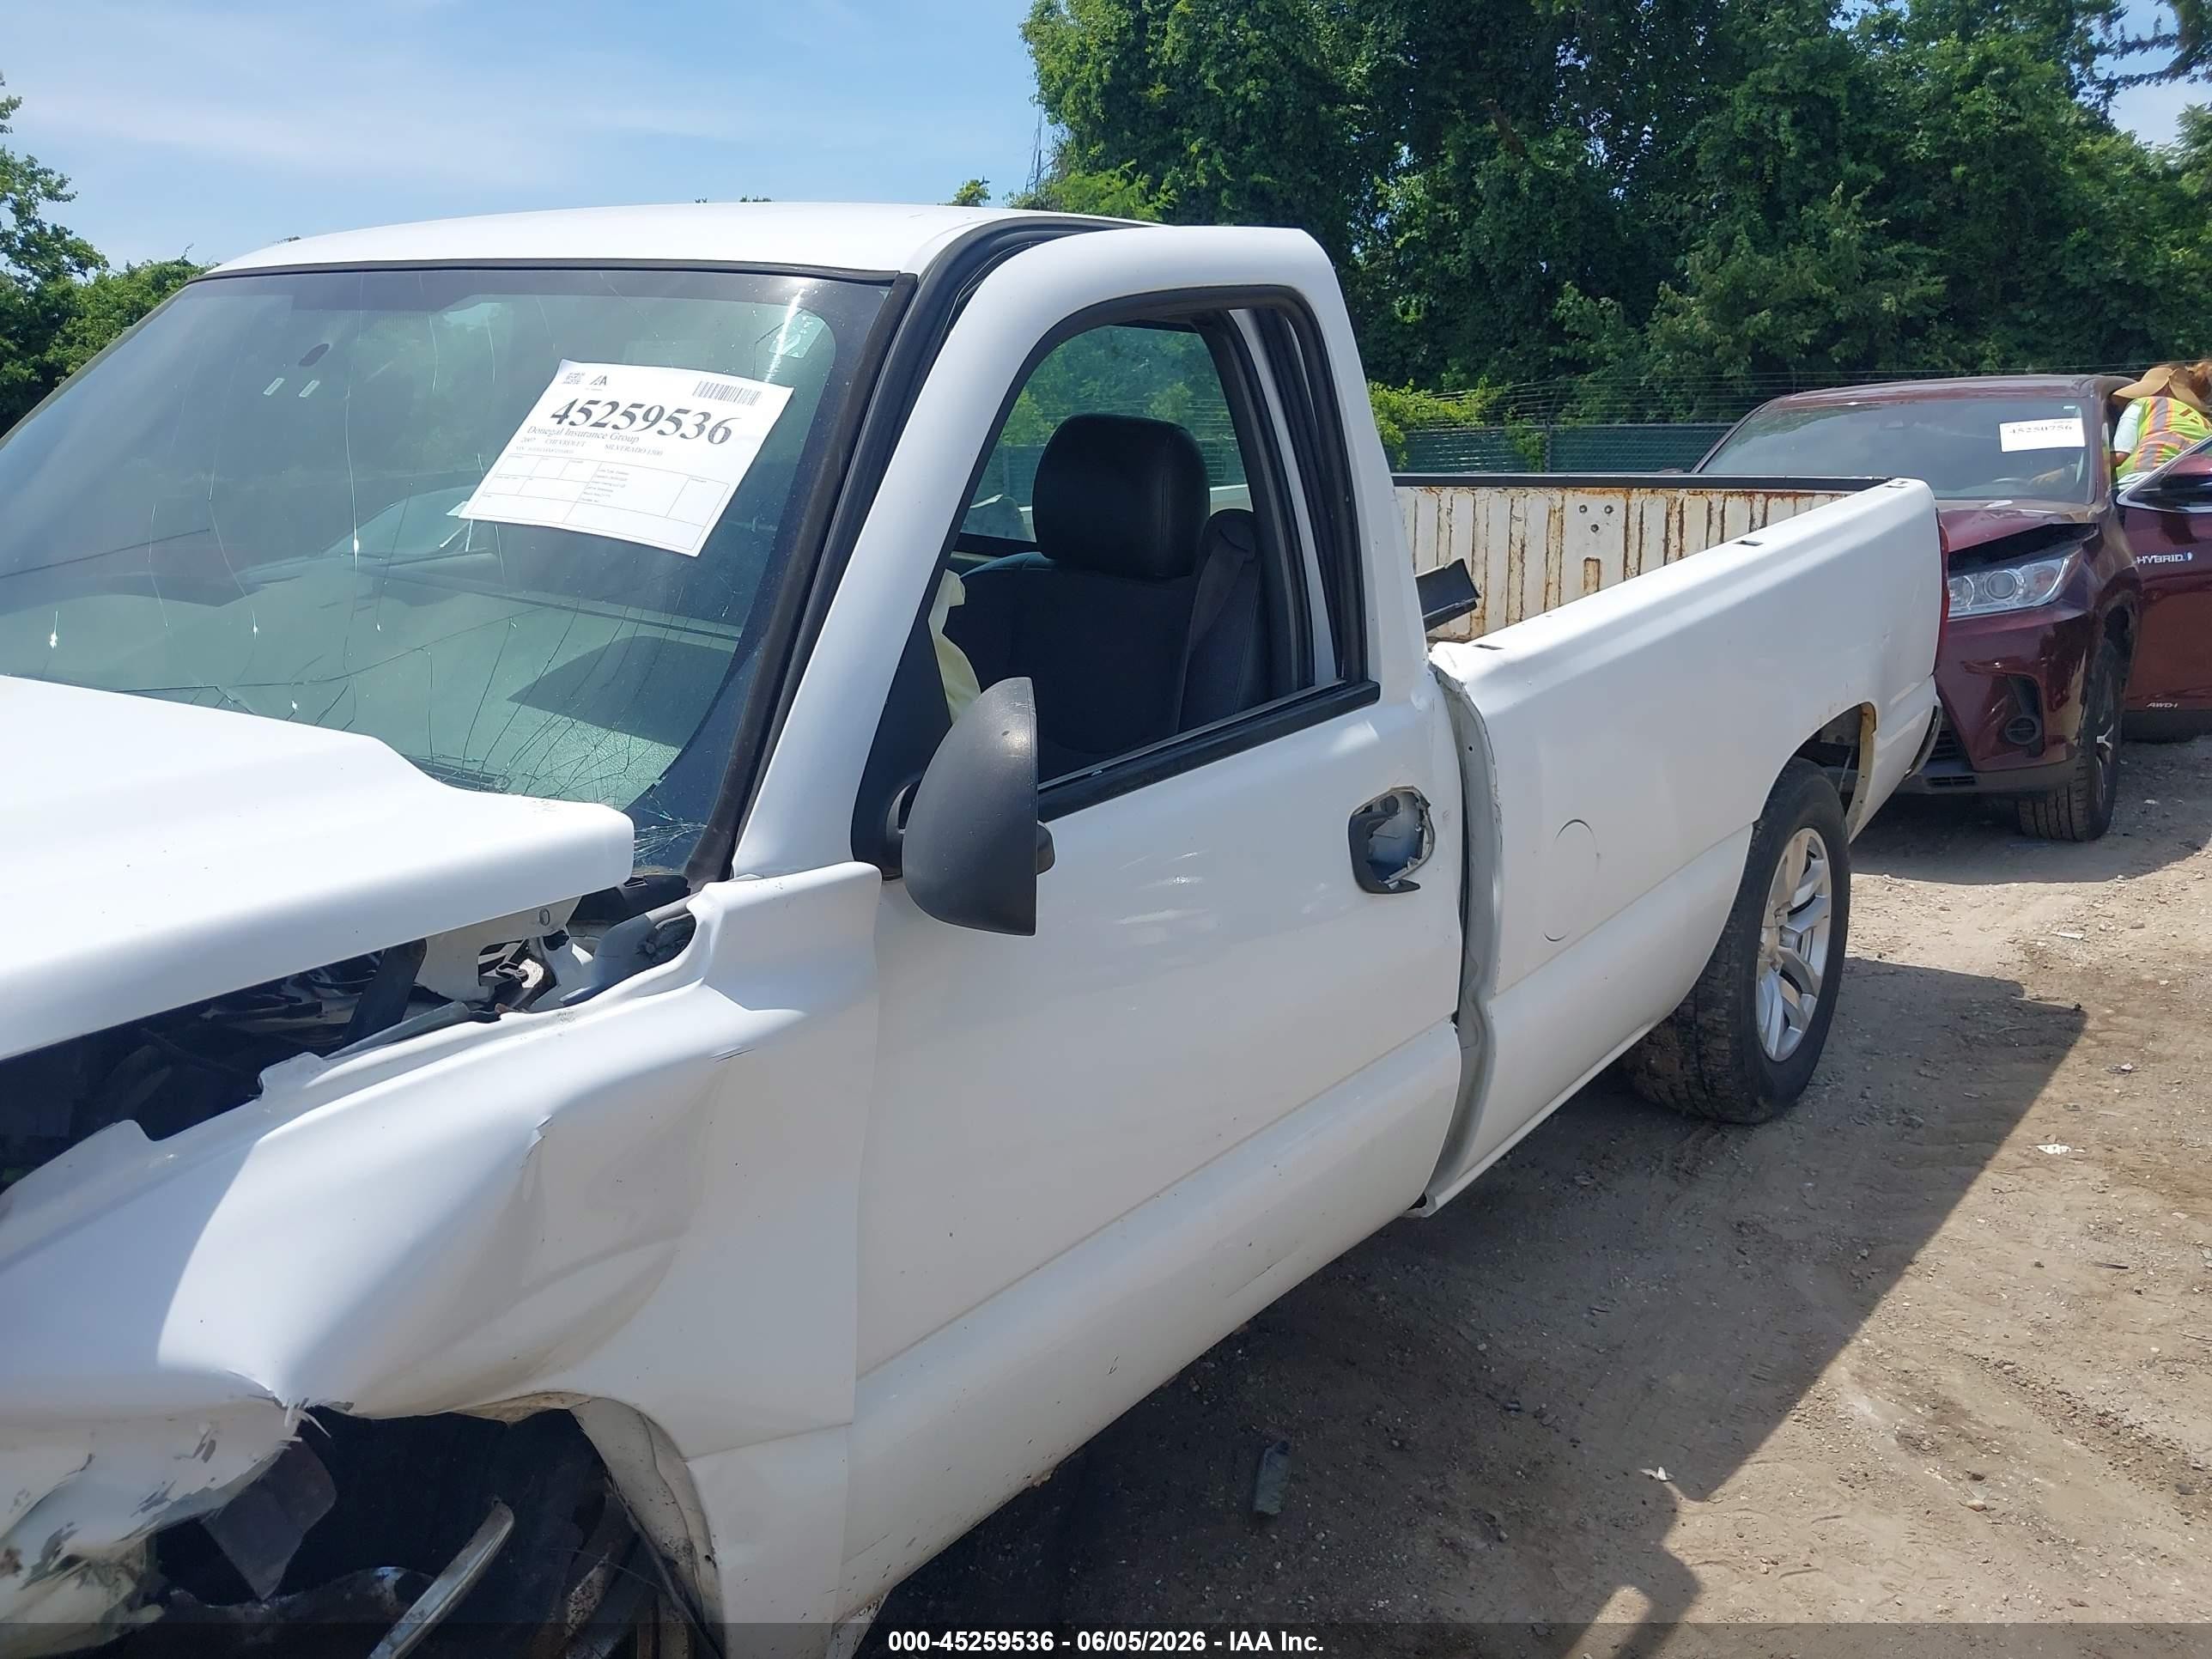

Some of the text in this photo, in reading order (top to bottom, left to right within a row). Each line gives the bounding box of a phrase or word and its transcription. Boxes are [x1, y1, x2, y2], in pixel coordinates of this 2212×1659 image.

[550, 398, 742, 445] 45259536
[527, 425, 640, 444] Donegal Insurance Group
[2136, 554, 2186, 564] HYBRID
